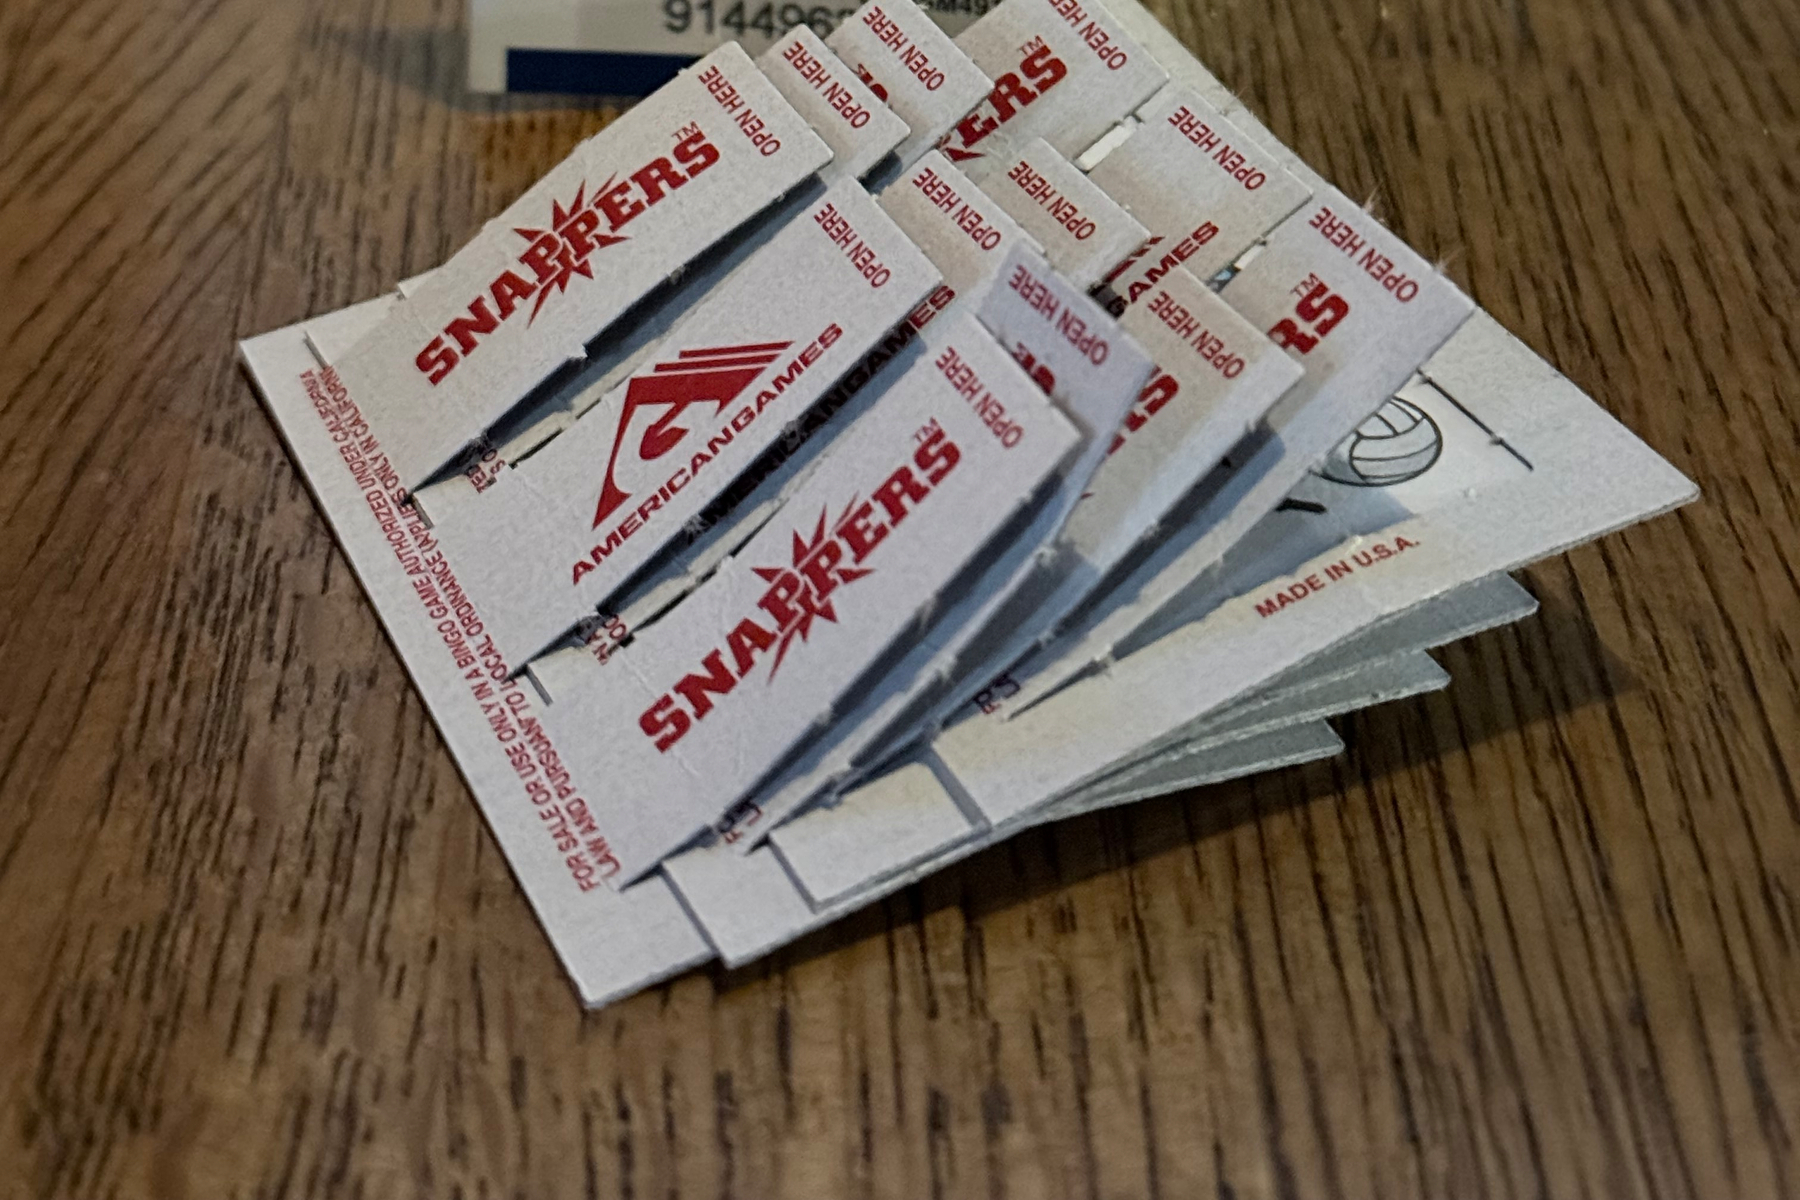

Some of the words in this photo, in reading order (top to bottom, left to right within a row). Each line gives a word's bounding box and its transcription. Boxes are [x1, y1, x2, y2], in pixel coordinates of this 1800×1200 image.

[862, 5, 909, 52] HERE
[1079, 21, 1128, 70] OPEN
[697, 64, 745, 114] HERE
[782, 40, 832, 89] HERE
[900, 44, 946, 91] OPEN
[822, 80, 872, 129] OPEN
[1168, 106, 1221, 152] HERE
[734, 107, 782, 157] OPEN
[912, 167, 961, 214] HERE
[1008, 160, 1058, 206] HERE
[1213, 143, 1267, 191] OPEN
[813, 202, 858, 249] HERE
[953, 204, 1002, 251] OPEN
[1046, 195, 1097, 242] OPEN
[1309, 206, 1365, 256] HERE
[415, 133, 720, 387] SNAPPERS
[847, 240, 892, 289] OPEN
[1359, 248, 1420, 302] OPEN
[1009, 264, 1061, 321] HERE
[1146, 291, 1201, 340] HERE
[1055, 309, 1109, 366] OPEN
[1190, 328, 1246, 379] OPEN
[936, 346, 984, 401] HERE
[359, 434, 380, 454] IN
[975, 392, 1024, 448] OPEN
[339, 438, 377, 491] UNDER
[369, 451, 400, 491] ONLY
[365, 490, 425, 576] AUTHORIZED
[412, 575, 449, 619] GAME
[425, 550, 484, 636] ORDINANCE
[637, 428, 961, 754] SNAPPERS
[1254, 573, 1326, 618] MADE
[1324, 559, 1353, 582] IN
[1351, 535, 1421, 568] U.S.A.
[437, 619, 476, 669] BINGO
[476, 633, 518, 692] LOCAL
[465, 667, 485, 680] A
[471, 680, 495, 701] IN
[480, 701, 517, 743] ONLY
[505, 691, 531, 717] TO
[505, 742, 536, 779] USE
[517, 717, 577, 799] PURSUANT
[525, 776, 552, 805] OR
[538, 804, 578, 852] SALE
[566, 798, 600, 836] AND
[566, 851, 600, 892] FOR
[586, 836, 621, 880] LAW
